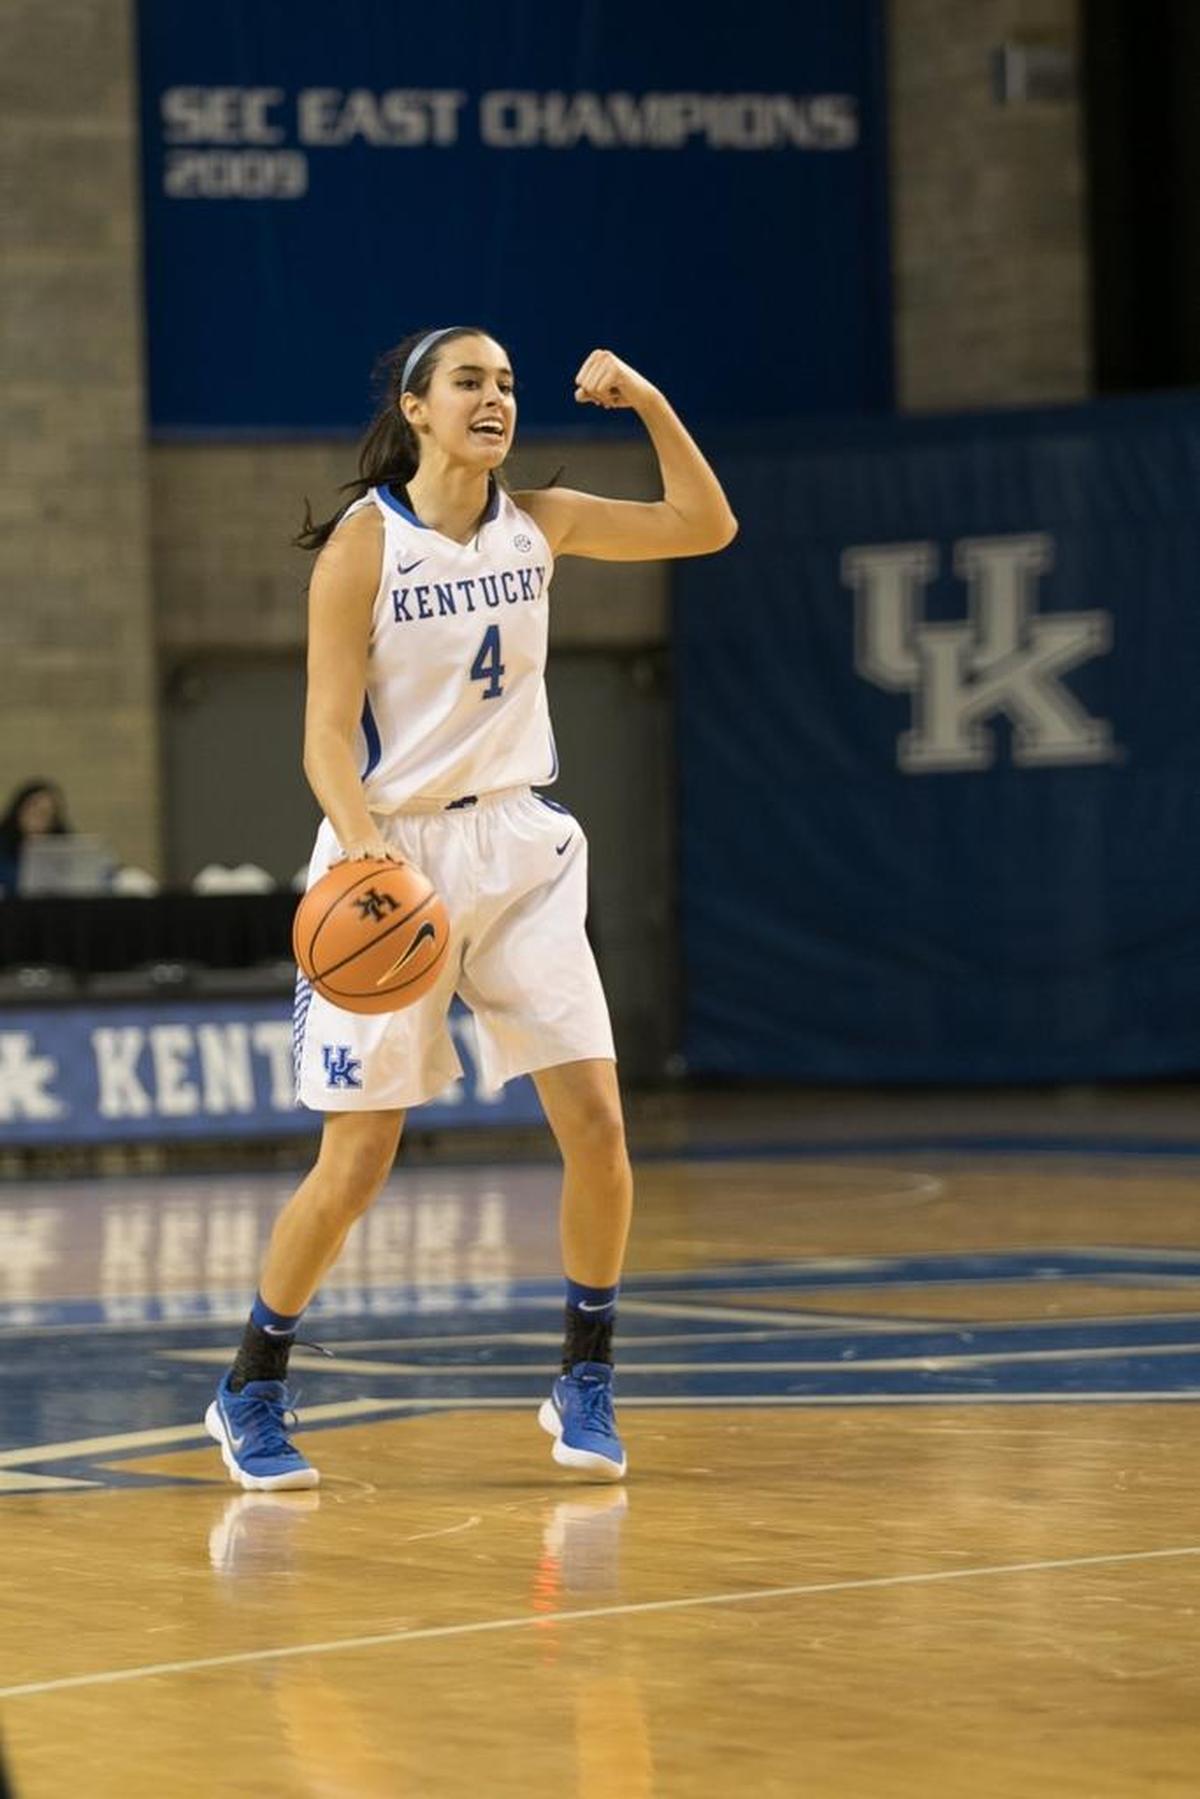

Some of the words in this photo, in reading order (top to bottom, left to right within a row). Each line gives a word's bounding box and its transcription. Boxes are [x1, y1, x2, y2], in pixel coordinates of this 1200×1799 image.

[162, 87, 284, 145] SEC
[299, 88, 466, 146] EAST
[480, 89, 860, 151] CHAMPIONS
[163, 148, 308, 200] 2009
[469, 624, 506, 701] 4
[840, 533, 1117, 774] UK
[321, 1045, 363, 1089] UK
